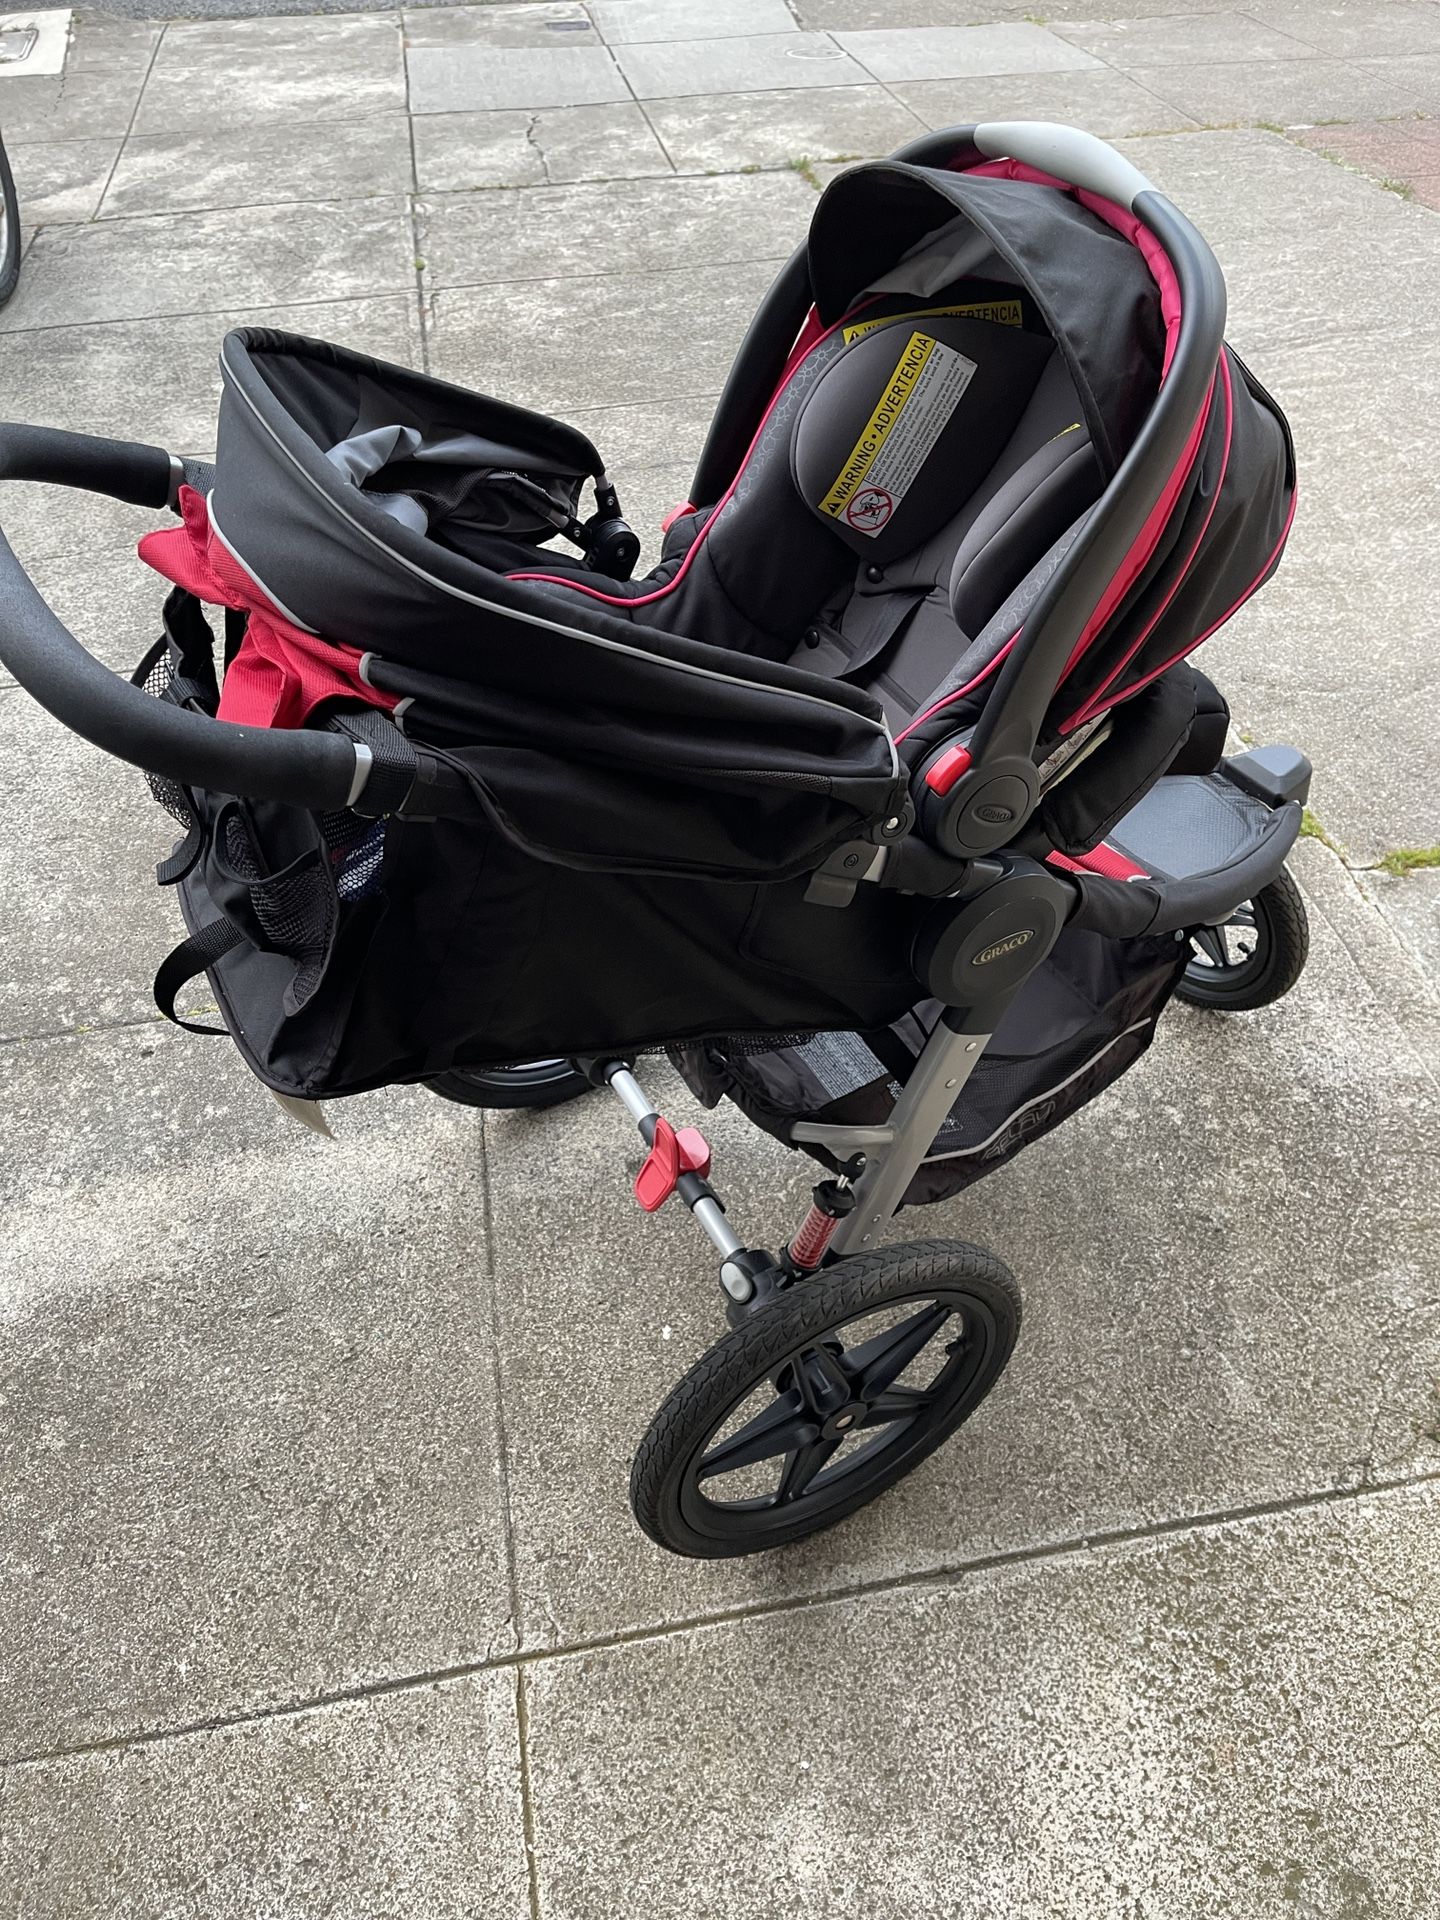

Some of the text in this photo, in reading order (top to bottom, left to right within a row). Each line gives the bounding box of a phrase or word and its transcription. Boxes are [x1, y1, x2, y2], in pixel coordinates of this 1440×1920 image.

[832, 334, 930, 502] WARNING ADVERTENCIA
[981, 934, 1029, 962] GRACO
